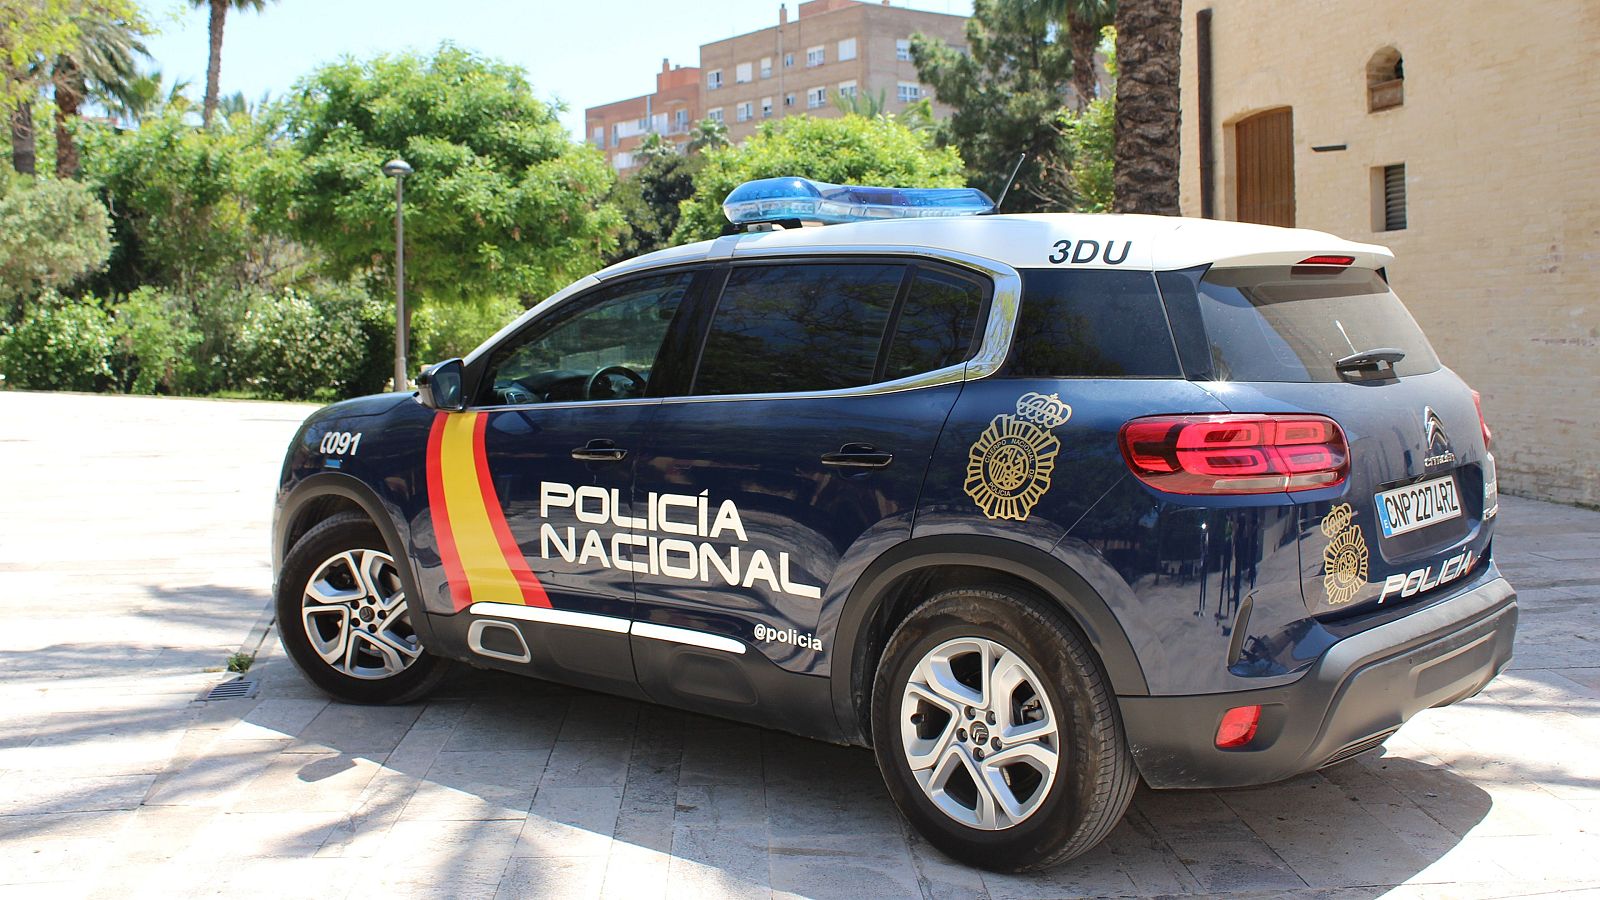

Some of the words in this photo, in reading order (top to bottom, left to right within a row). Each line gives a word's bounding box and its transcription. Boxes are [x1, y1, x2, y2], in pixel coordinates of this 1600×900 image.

[1048, 239, 1133, 265] 3DU
[985, 440, 1007, 463] CUERPO
[1011, 438, 1035, 463] NACIONAL
[1028, 469, 1035, 480] DE
[988, 481, 1011, 497] POLICIA
[540, 481, 748, 542] POLICÍA
[1385, 493, 1411, 529] CNP
[540, 523, 821, 599] NACIONAL
[1377, 546, 1474, 604] POLICÍA
[753, 624, 823, 651] @policia
